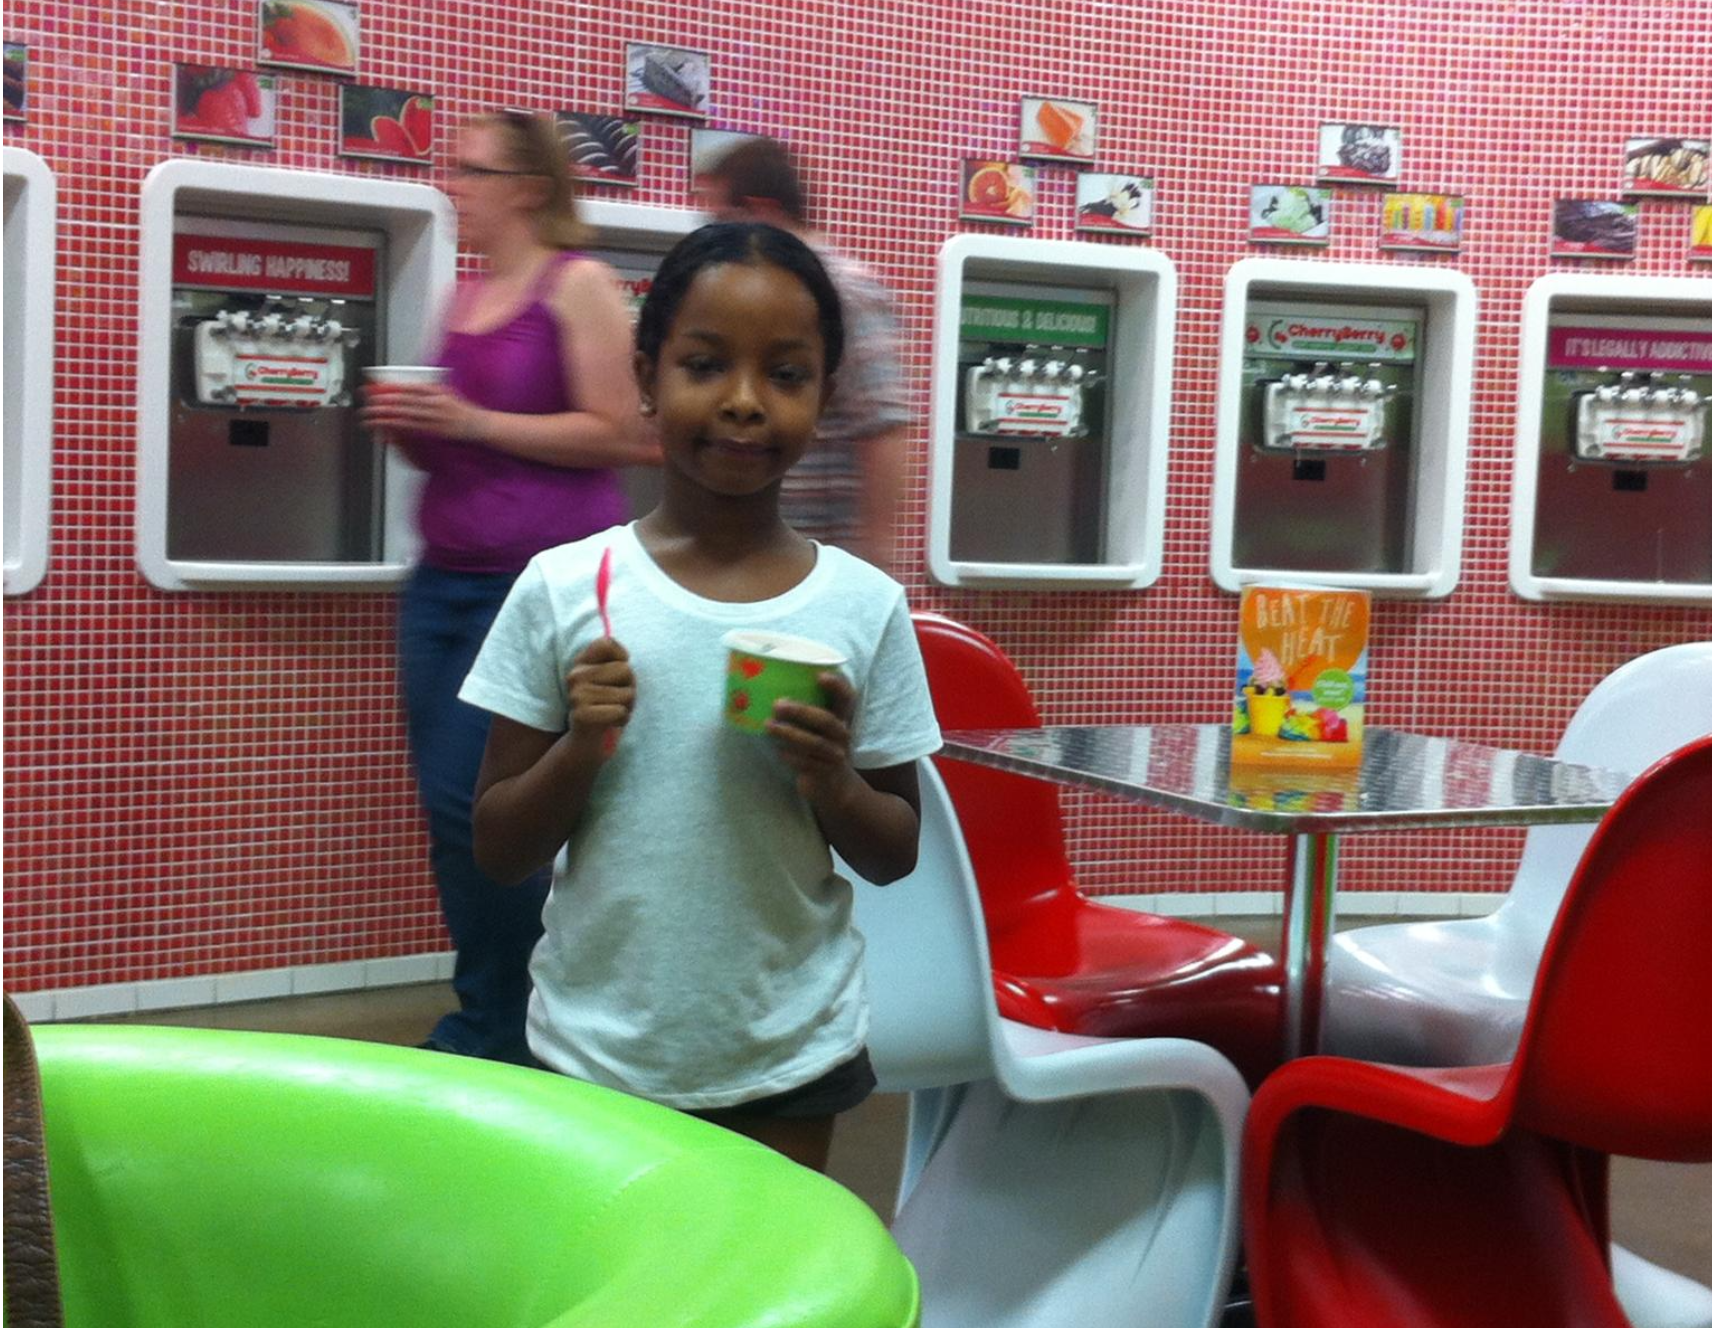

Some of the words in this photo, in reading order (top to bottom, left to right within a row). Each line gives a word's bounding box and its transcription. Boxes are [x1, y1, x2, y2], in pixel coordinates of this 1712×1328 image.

[187, 250, 262, 276] SWIRLING
[265, 255, 351, 282] HAPPINESS!
[1021, 309, 1034, 329] &
[1288, 323, 1386, 344] CherryBerry
[1591, 338, 1648, 359] LEGALLY
[1256, 593, 1310, 629] BEAT
[1319, 597, 1355, 628] THE
[1281, 625, 1343, 666] HEAT
